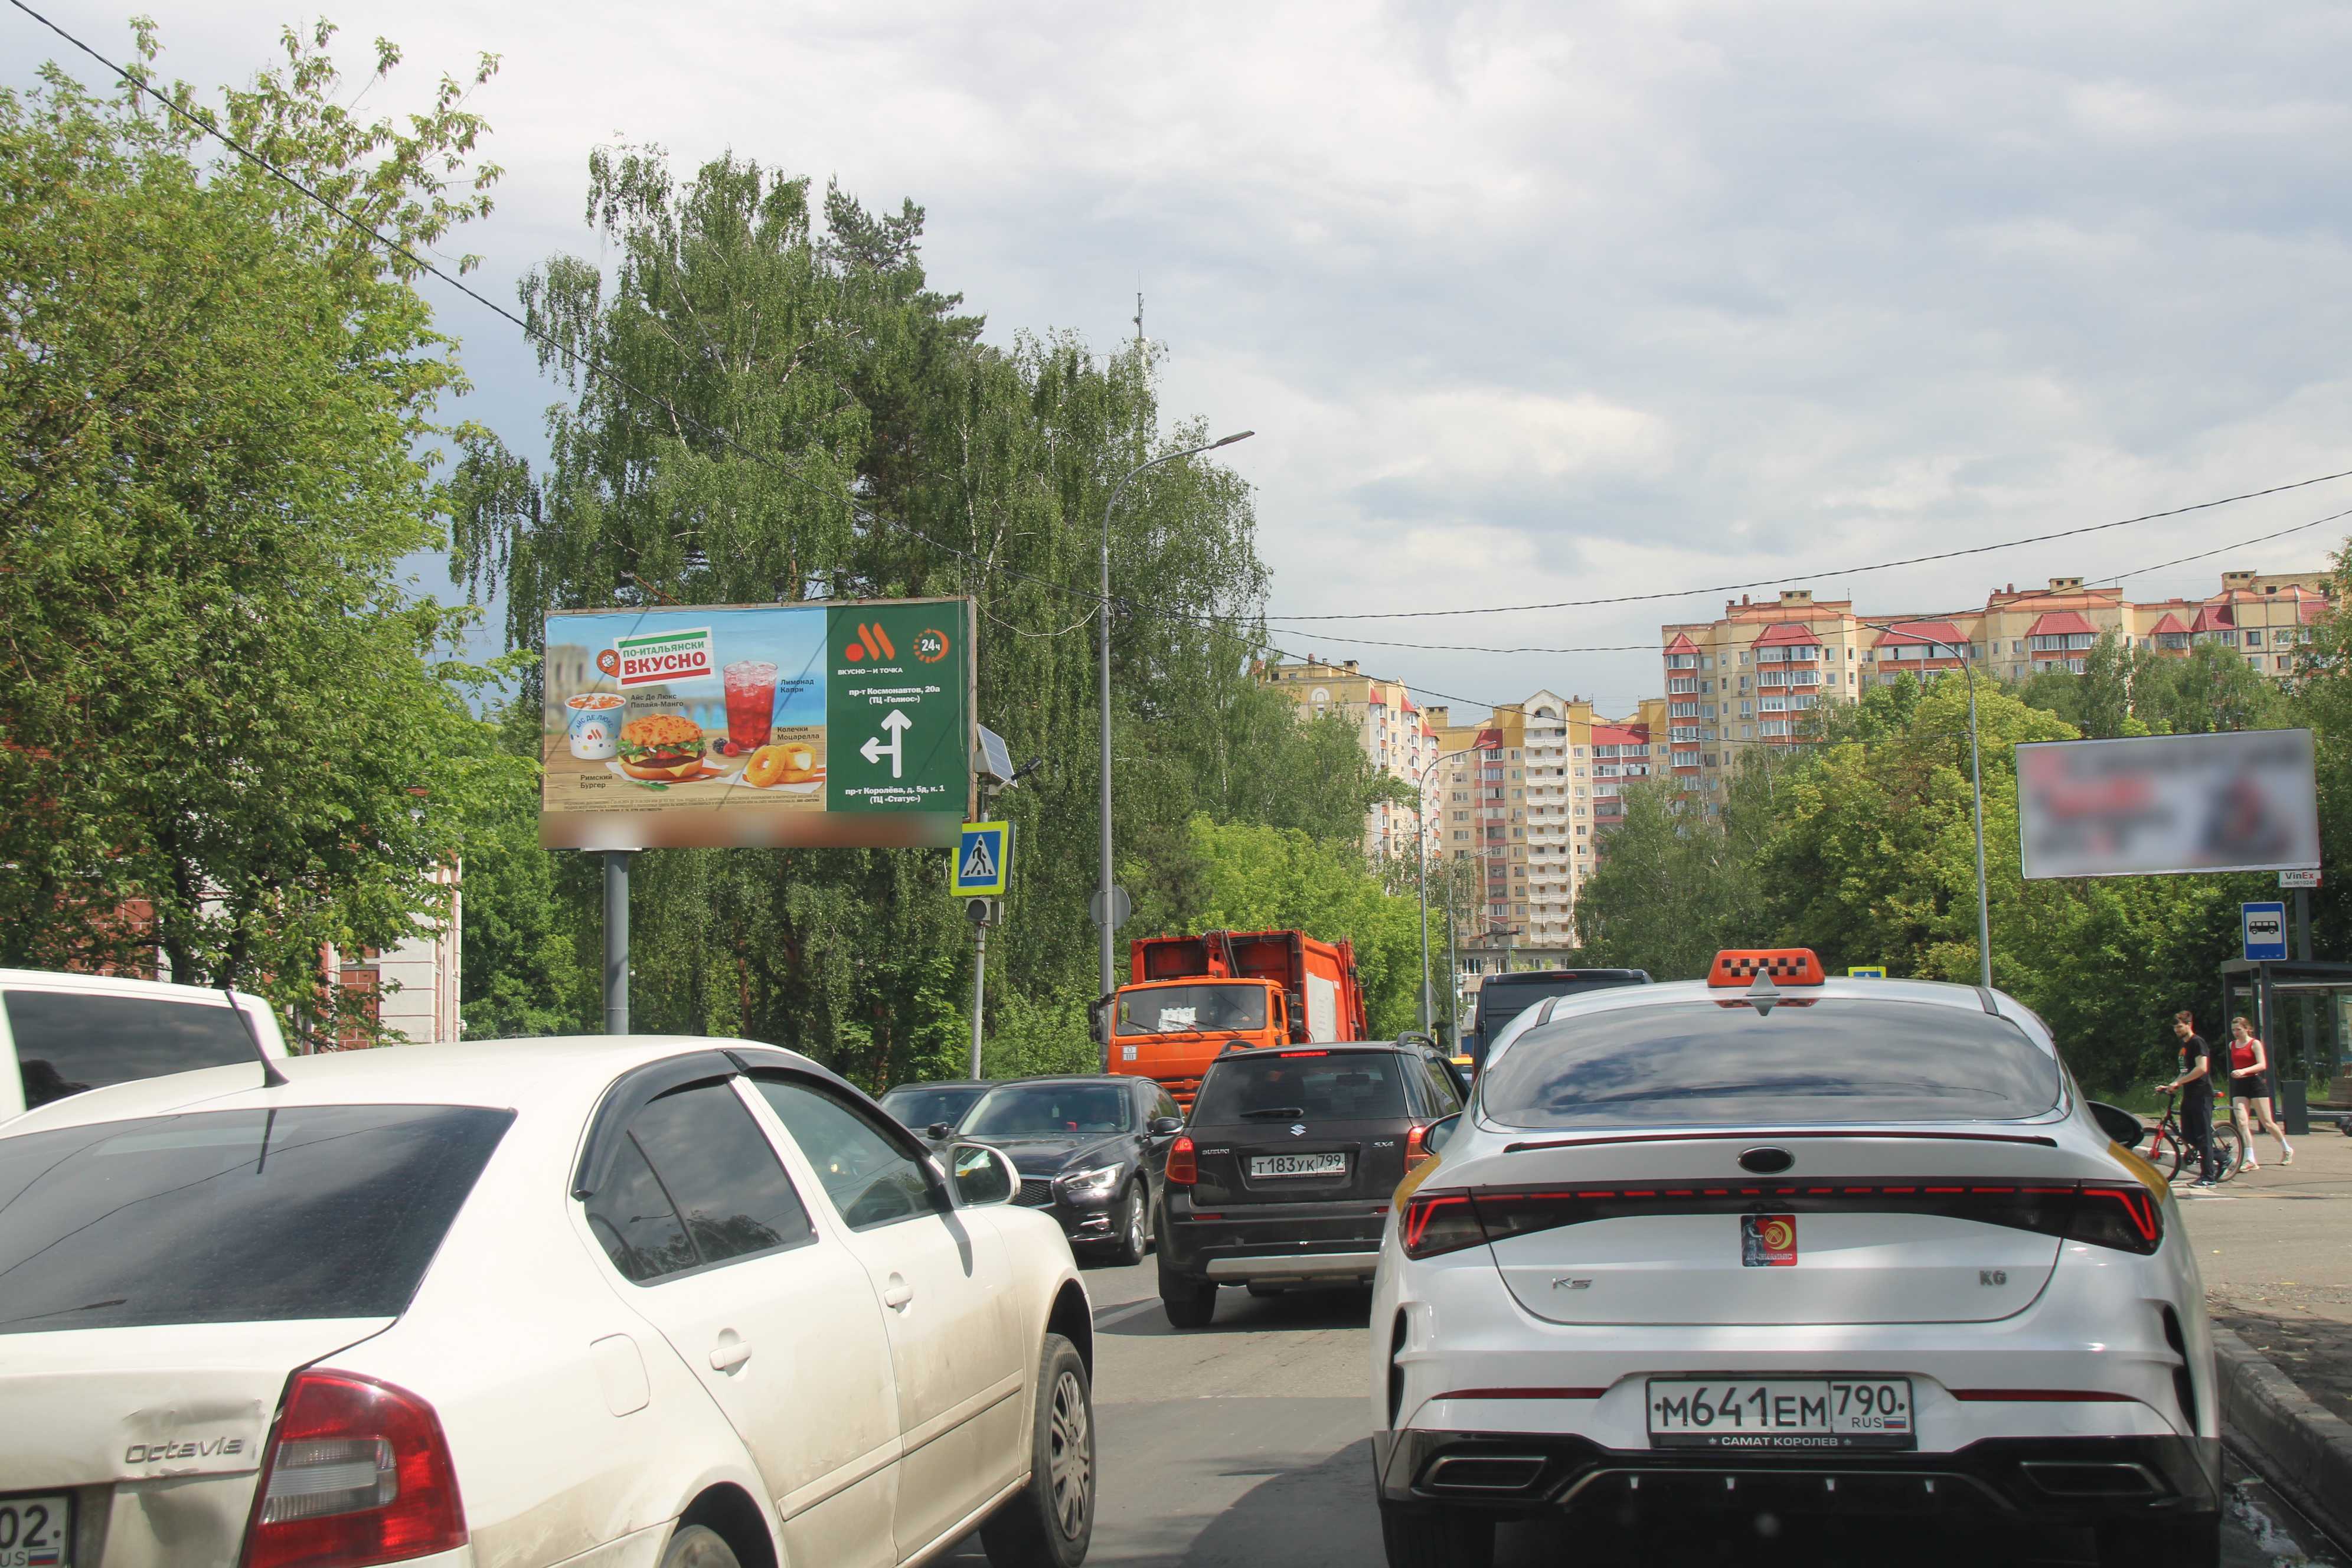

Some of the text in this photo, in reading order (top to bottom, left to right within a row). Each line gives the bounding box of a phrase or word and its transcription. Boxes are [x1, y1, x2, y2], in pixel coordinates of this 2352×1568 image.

[623, 641, 704, 658] ПО-ИТАЛЬЯНСКИ
[624, 651, 706, 675] ВКУСНО
[869, 696, 883, 705] (ТЦ
[864, 786, 906, 794] Королёва,
[870, 795, 920, 804] (ТЦ «Статус»)
[1318, 1154, 1341, 1167] 799
[1979, 1270, 2007, 1286] KG
[1832, 1384, 1896, 1416] 790
[1852, 1417, 1883, 1428] RUS
[1721, 1436, 1838, 1447] САМАТ КОРОЛЕВ
[125, 1436, 245, 1464] Octavia
